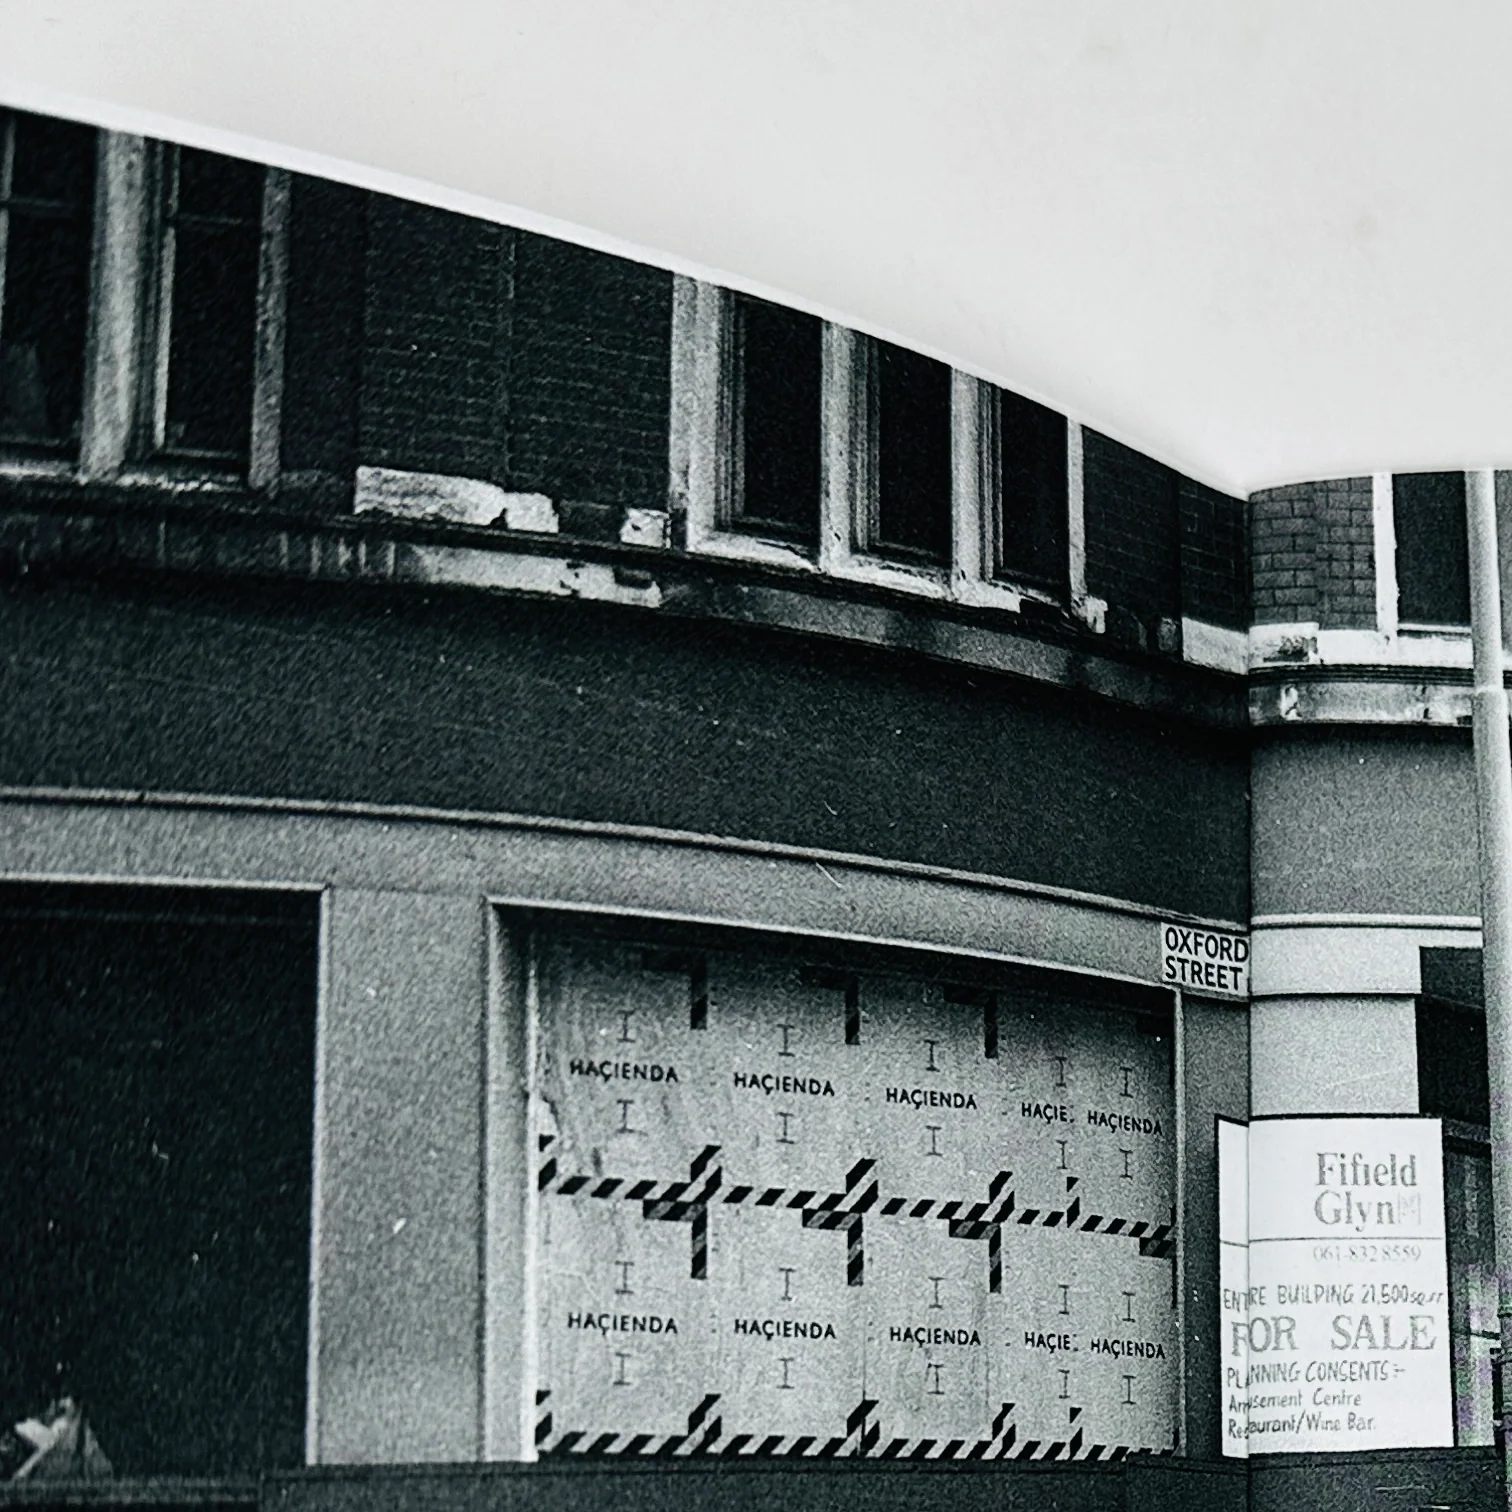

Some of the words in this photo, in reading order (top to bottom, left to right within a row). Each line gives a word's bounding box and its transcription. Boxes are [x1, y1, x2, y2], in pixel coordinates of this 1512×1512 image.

[1165, 927, 1249, 962] OXFORD
[1165, 956, 1243, 991] STREET
[570, 1060, 679, 1085] HAÇIENDA
[732, 1071, 836, 1096] HAÇIENDA
[885, 1087, 978, 1111] HAÇIENDA
[1087, 1112, 1163, 1138] HAÇIENDA
[1314, 1152, 1418, 1187] Fifield
[1277, 1282, 1354, 1306] BUILDING
[567, 1312, 679, 1340] HAÇIENDA
[733, 1318, 836, 1341] HAÇIENDA
[889, 1326, 981, 1348] HAÇIENDA
[1230, 1315, 1300, 1357] FOR
[1330, 1314, 1437, 1351] SALE
[1090, 1338, 1165, 1360] HAÇIENDA
[1312, 1387, 1362, 1407] Centre
